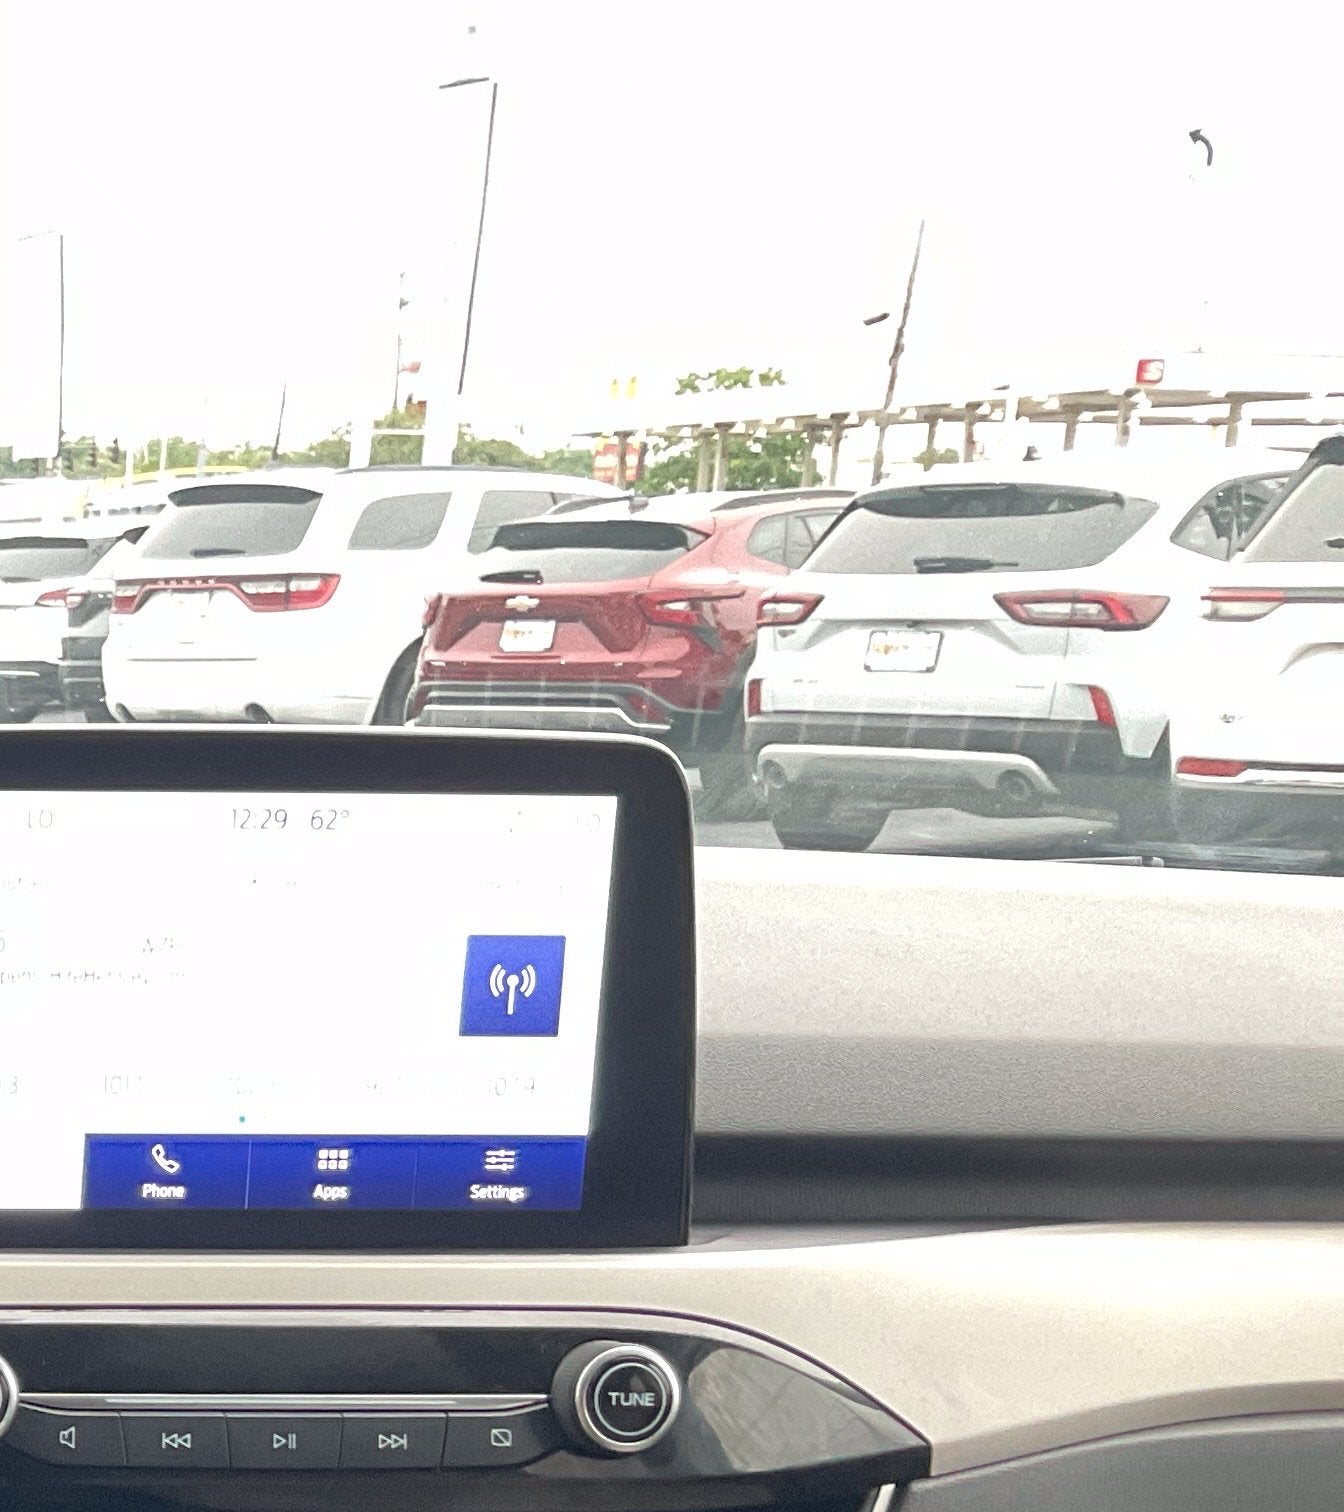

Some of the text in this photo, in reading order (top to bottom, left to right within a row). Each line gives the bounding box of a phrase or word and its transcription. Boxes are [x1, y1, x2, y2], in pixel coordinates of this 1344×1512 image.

[231, 808, 289, 830] 12:29
[141, 1183, 186, 1200] Phone
[313, 1183, 348, 1202] Apps
[469, 1183, 526, 1203] Settings
[607, 1391, 656, 1407] TUNE
